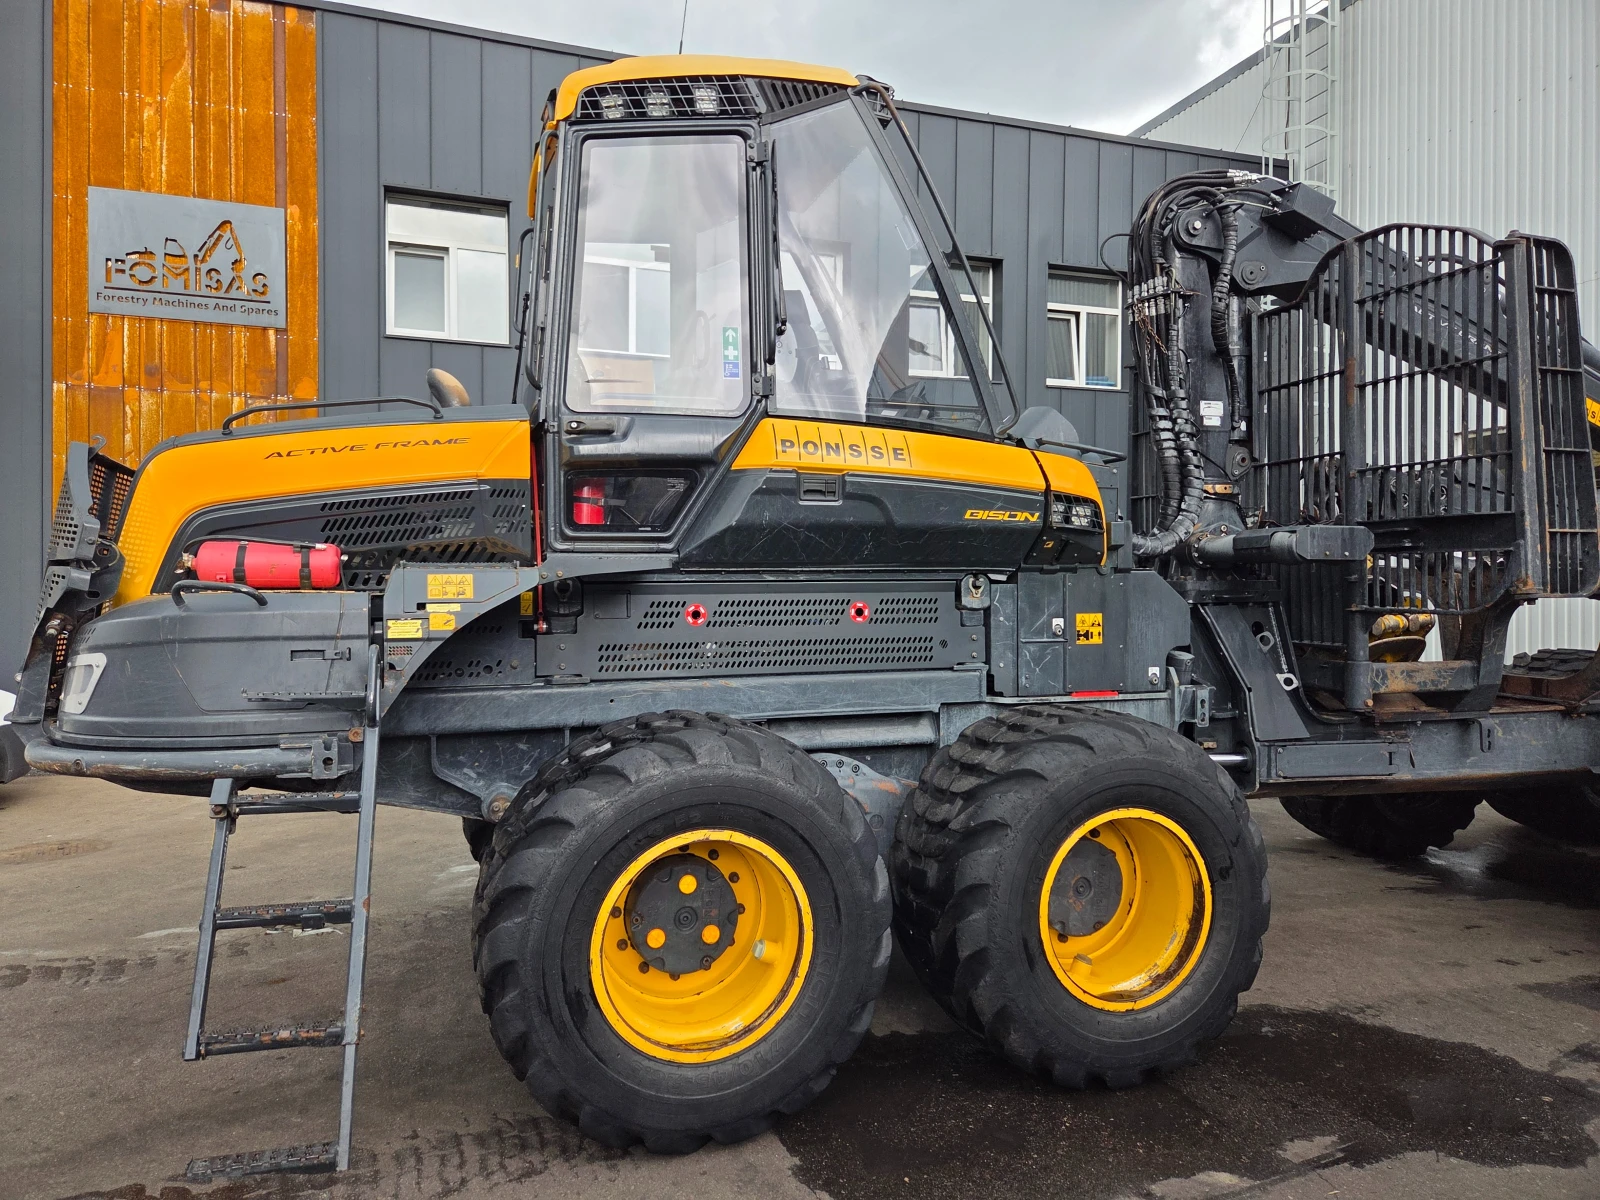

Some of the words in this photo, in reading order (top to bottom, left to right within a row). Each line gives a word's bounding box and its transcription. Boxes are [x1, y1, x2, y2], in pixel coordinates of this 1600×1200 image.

[96, 291, 149, 307] Forestry
[152, 297, 210, 311] Machines
[213, 302, 237, 313] And
[240, 304, 279, 317] Spares
[264, 443, 369, 460] ACTIVE
[374, 437, 471, 450] FRAME
[780, 438, 907, 462] PONSSE
[964, 509, 1040, 522] BISON
